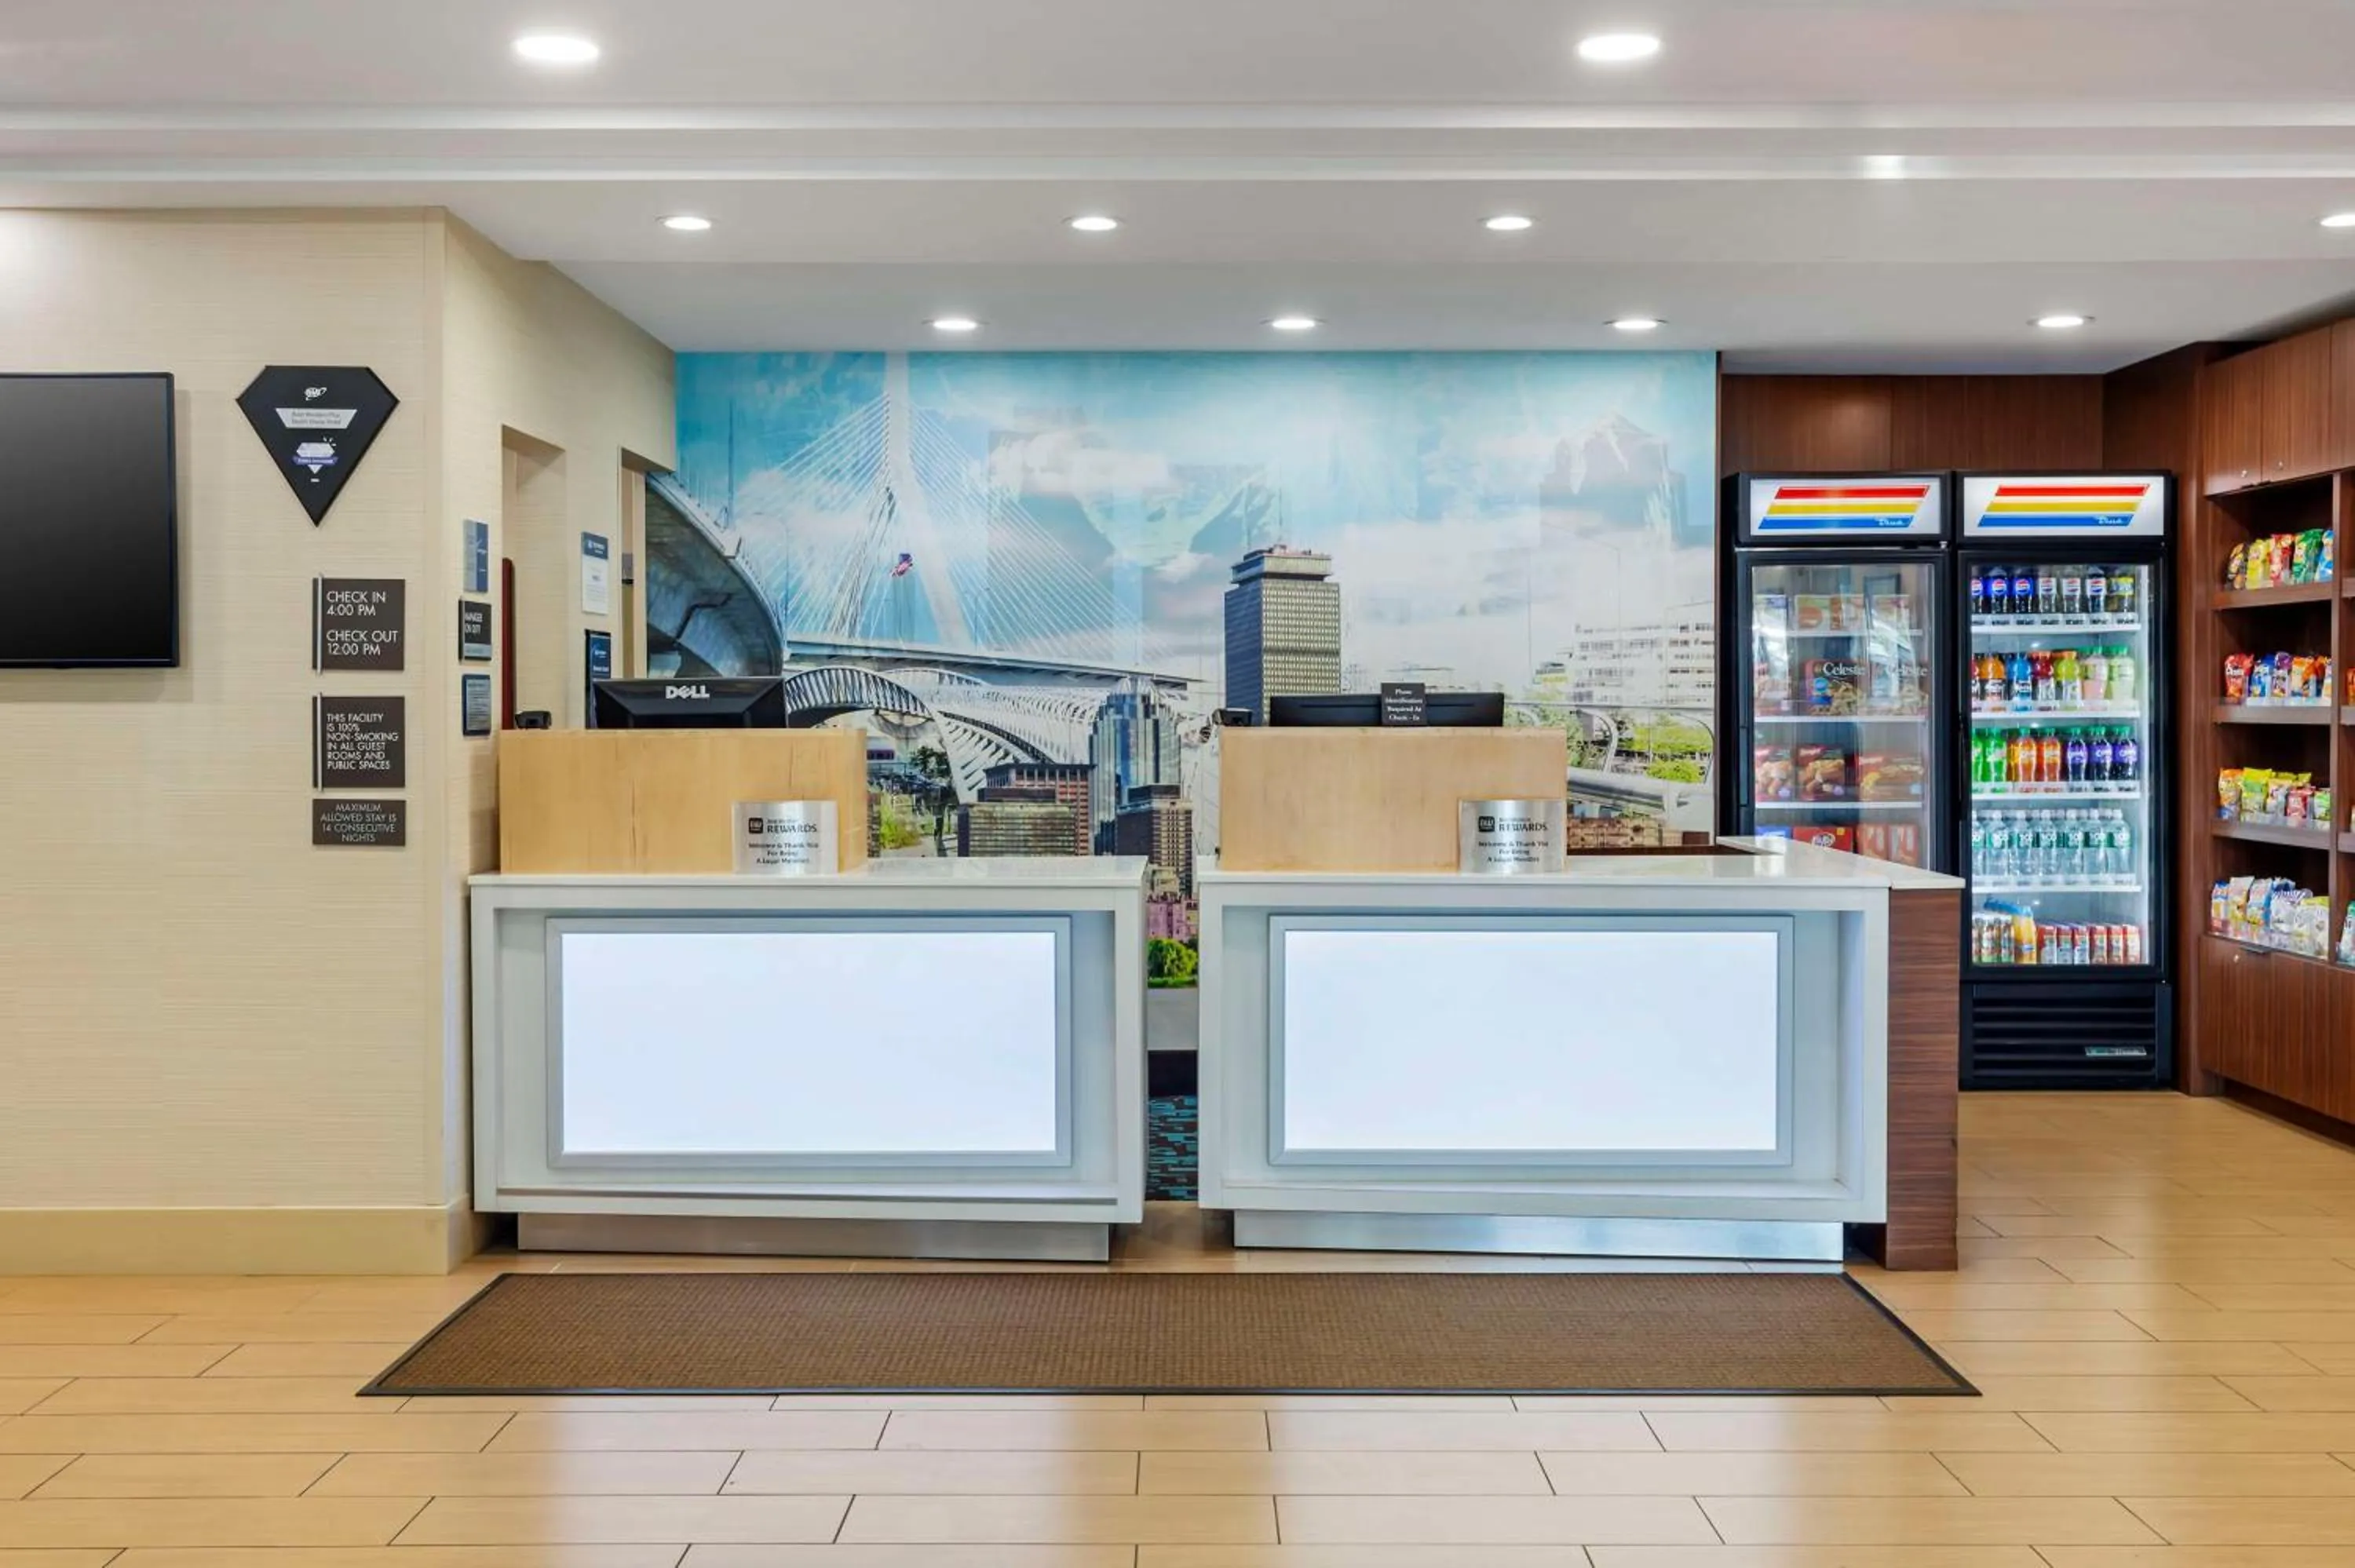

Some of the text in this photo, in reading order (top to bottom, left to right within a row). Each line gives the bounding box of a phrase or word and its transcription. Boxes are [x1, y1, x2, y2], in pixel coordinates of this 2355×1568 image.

[327, 591, 386, 603] CHECK IN
[358, 604, 376, 616] PM
[326, 629, 399, 643] CHECK OUT
[363, 643, 381, 655] PM
[1823, 662, 1866, 676] Celeste
[665, 685, 710, 699] DELL
[327, 713, 384, 723] THIS FACILITY
[327, 723, 360, 732] IS 100%
[327, 732, 399, 742] NON-SMOKING
[327, 742, 386, 751] IN ALL GUEST
[327, 751, 385, 760] ROOMS AND
[327, 760, 391, 770] PUBLIC SPACES
[335, 803, 382, 812] MAXIMUM
[319, 812, 397, 822] ALLOWED STAY IS
[323, 823, 396, 833] 14 CONSECUTIVE
[767, 823, 817, 833] REWARDS
[1499, 822, 1548, 832] REWARDS
[341, 833, 376, 842] NIGHTS
